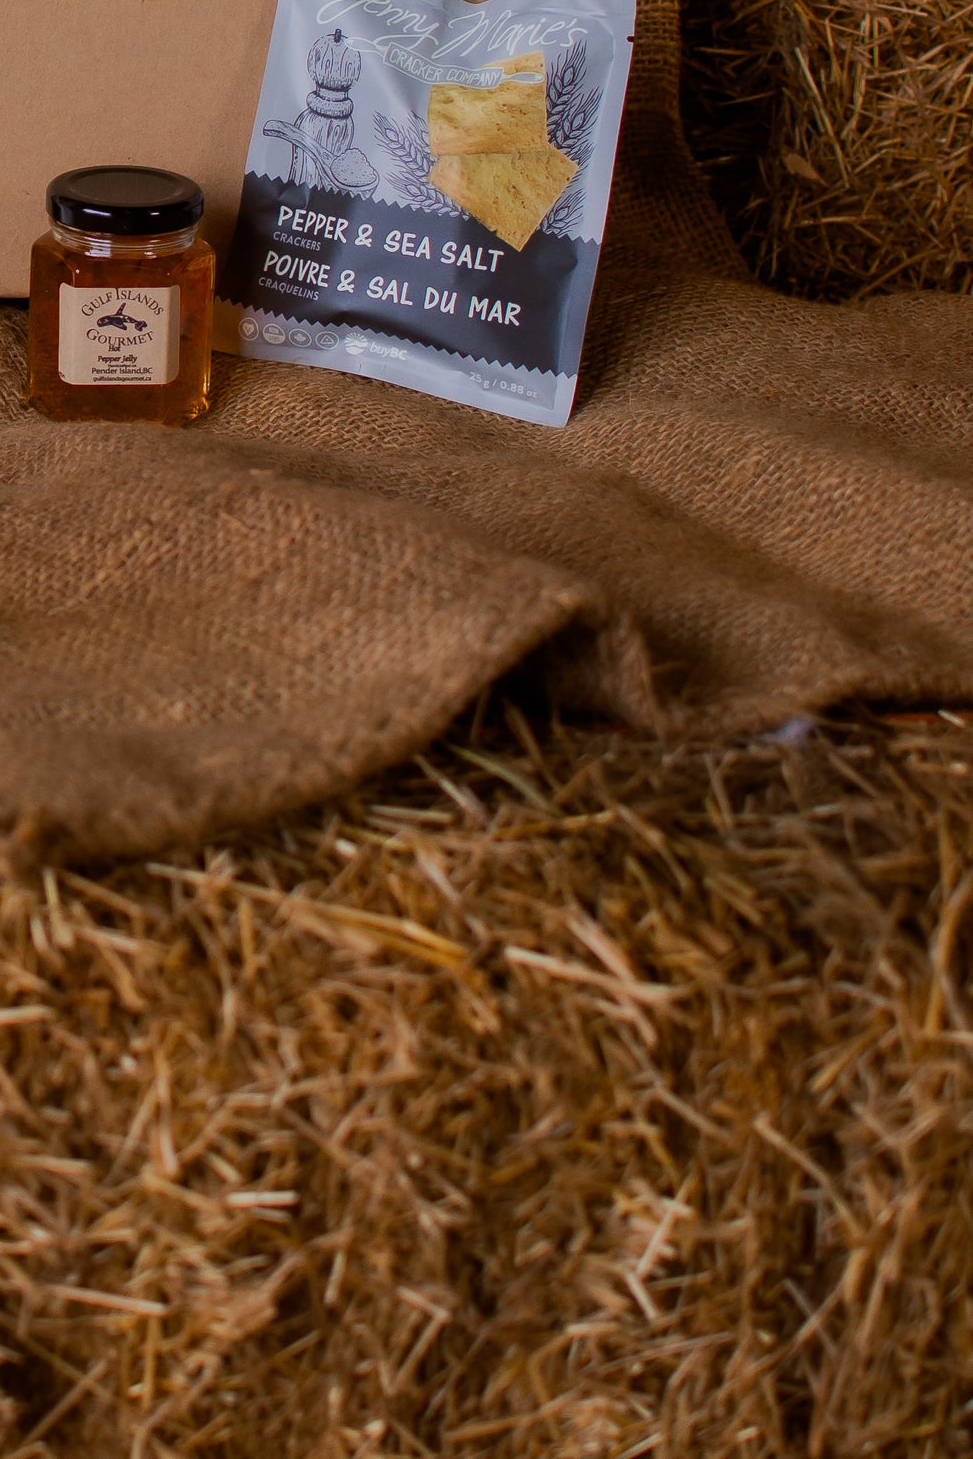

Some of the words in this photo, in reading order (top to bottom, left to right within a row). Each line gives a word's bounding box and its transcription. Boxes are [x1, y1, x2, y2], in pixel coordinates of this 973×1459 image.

[432, 10, 587, 59] Marie's
[389, 49, 443, 81] CRACKER
[446, 68, 502, 86] COMPANY
[273, 231, 321, 252] CRACKERS
[277, 205, 348, 243] PEPPER
[355, 224, 374, 247] &
[383, 229, 431, 260] SEA
[440, 241, 504, 272] SALT
[81, 291, 113, 316] GULF
[116, 288, 164, 316] ISLANDS
[258, 277, 319, 301] CRAQUELINS
[263, 250, 331, 288] POIVRE
[337, 269, 356, 293] &
[366, 276, 413, 306] SAL
[423, 287, 457, 314] DU
[468, 296, 521, 326] MAR
[87, 328, 154, 346] GOURMET
[469, 372, 482, 382] 25
[500, 381, 524, 394] 0.88
[527, 390, 537, 398] oz
